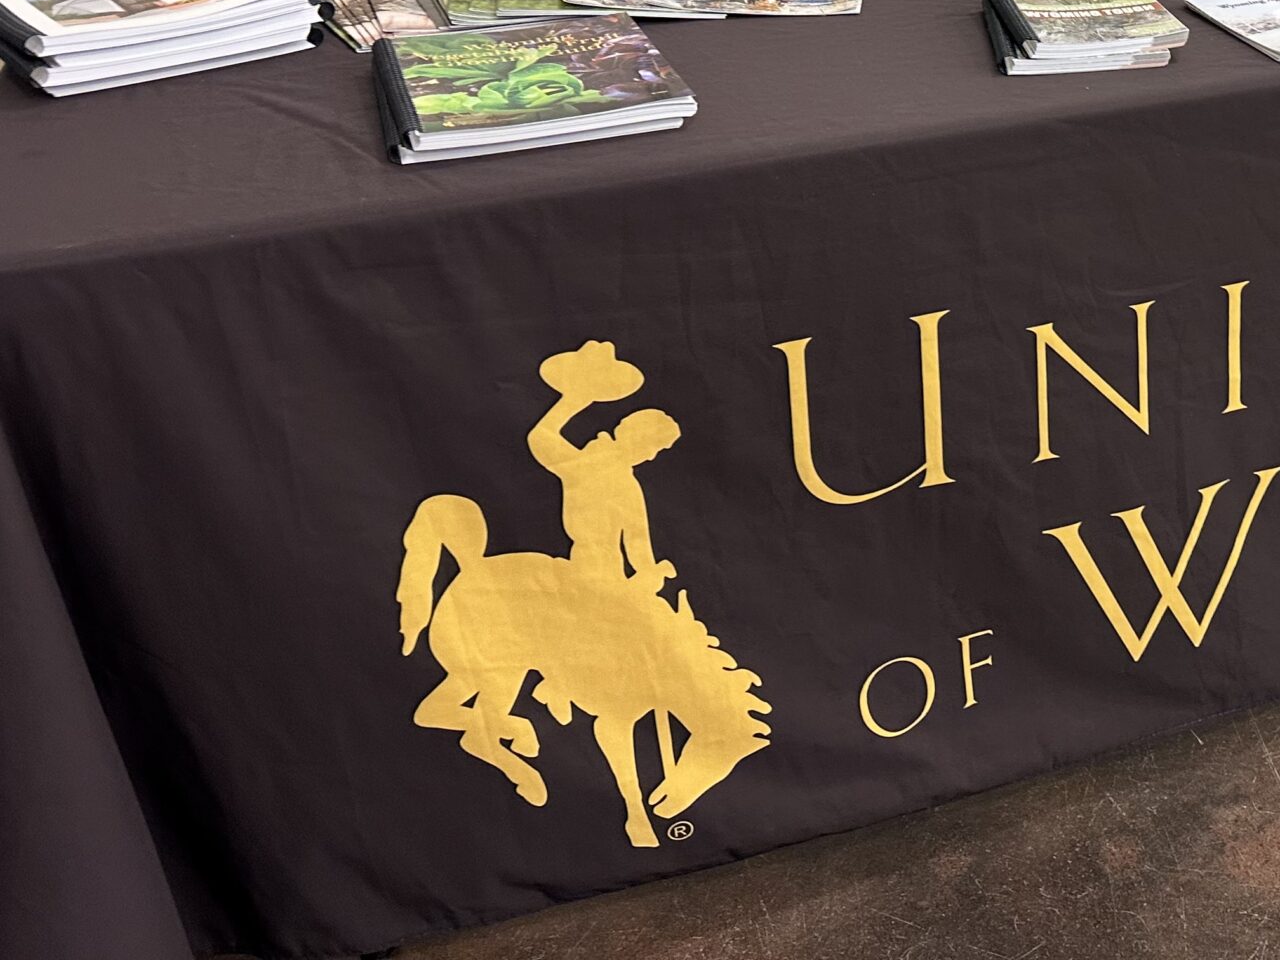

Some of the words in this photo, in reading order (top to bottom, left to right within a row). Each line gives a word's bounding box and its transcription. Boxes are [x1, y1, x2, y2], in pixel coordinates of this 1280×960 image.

[1023, 10, 1103, 18] WYOMING
[1102, 4, 1155, 16] TOUGH
[1216, 0, 1267, 9] Wyoming
[859, 629, 995, 738] OF
